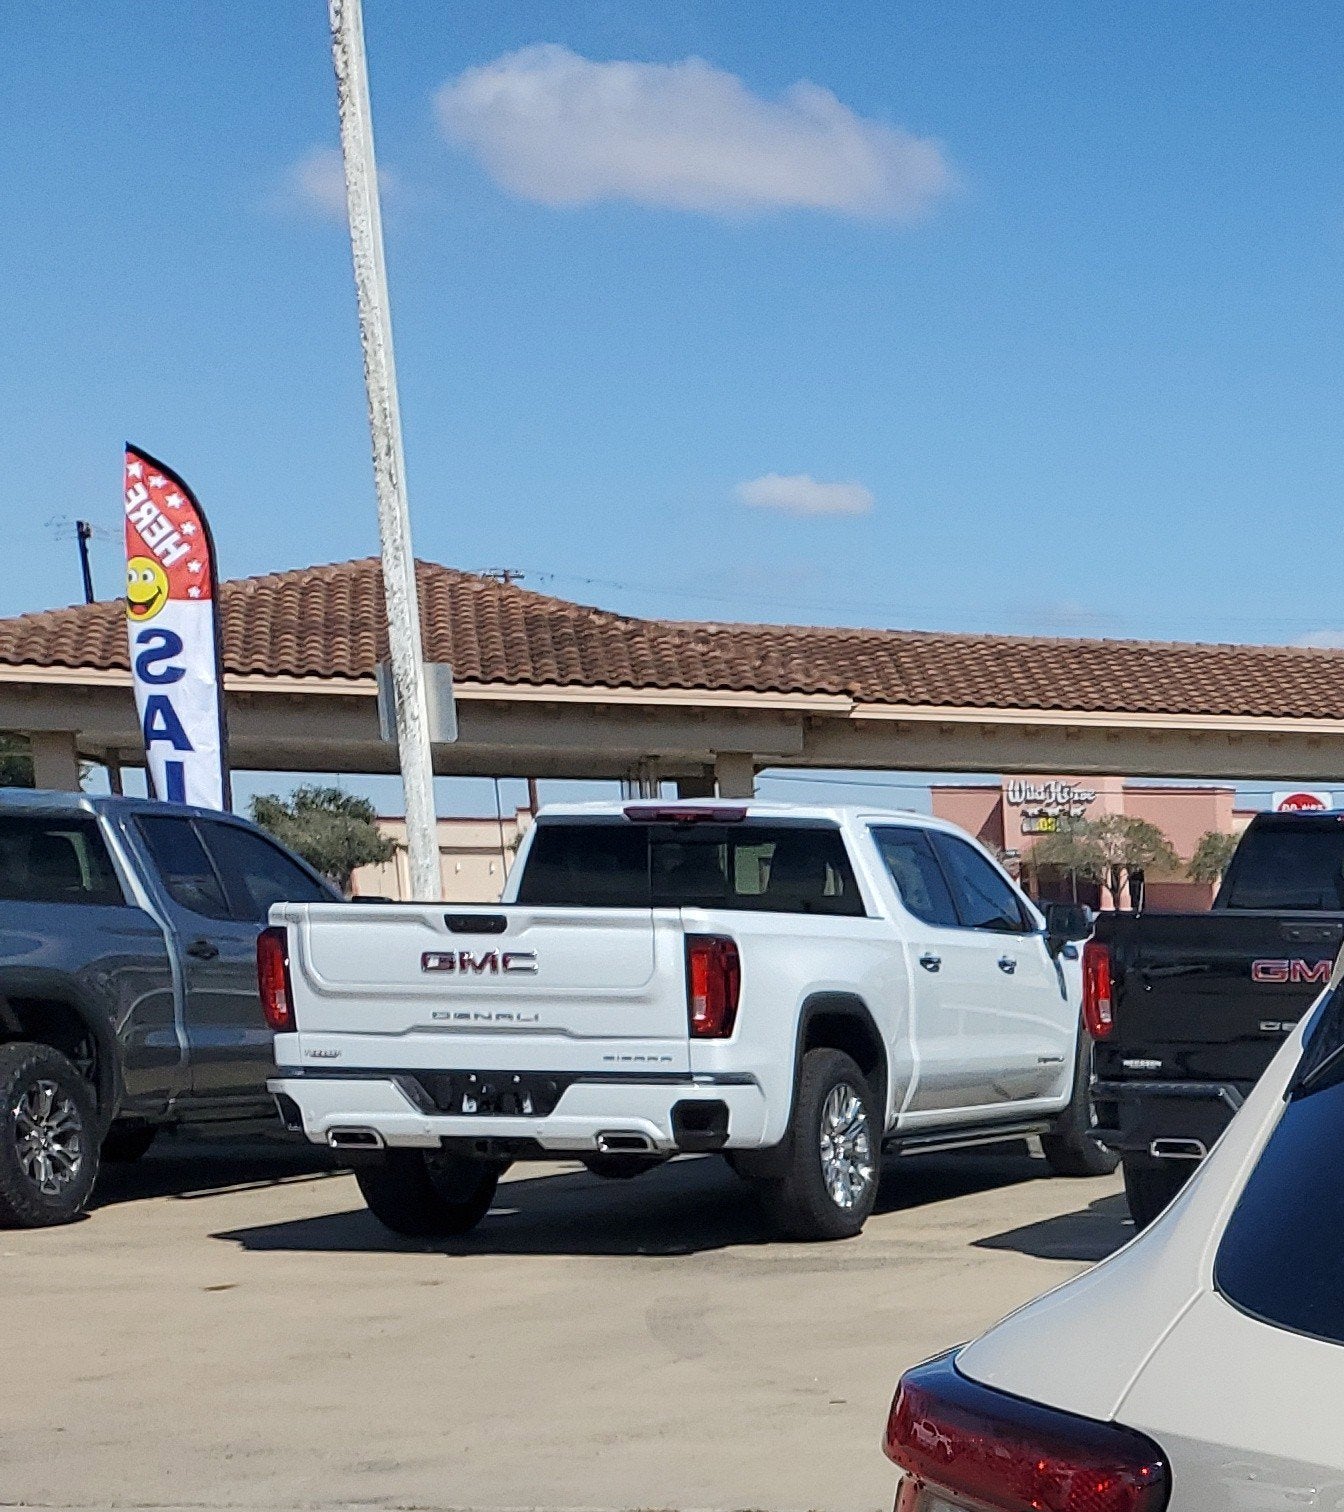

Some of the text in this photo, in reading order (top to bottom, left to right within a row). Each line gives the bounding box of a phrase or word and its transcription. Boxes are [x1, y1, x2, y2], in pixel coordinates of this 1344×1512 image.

[421, 951, 539, 975] GMC
[1252, 959, 1333, 982] GM
[432, 1011, 539, 1022] DENALI
